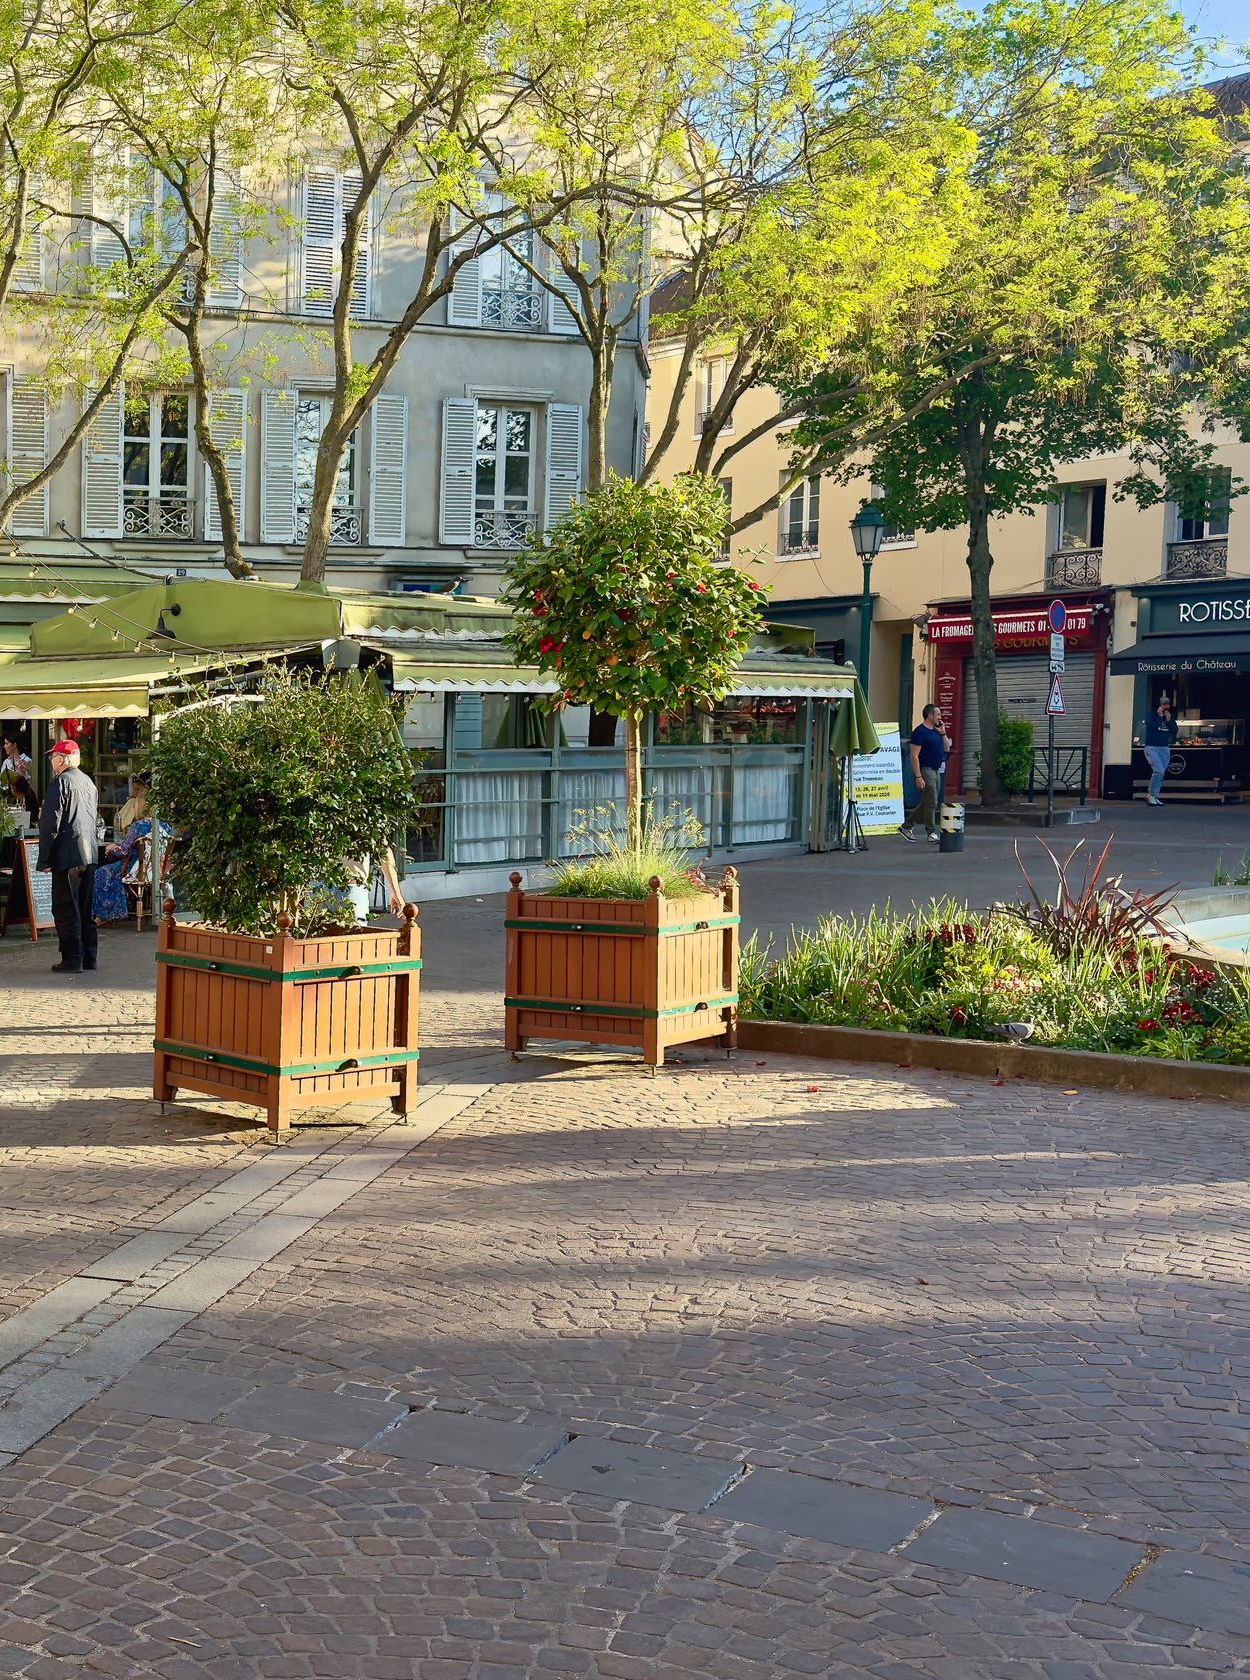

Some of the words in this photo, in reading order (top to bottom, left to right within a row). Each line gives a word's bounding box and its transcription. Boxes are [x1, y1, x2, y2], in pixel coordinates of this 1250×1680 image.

[931, 627, 940, 638] LA
[998, 620, 1035, 634] GOURMETS
[1037, 620, 1046, 632] 01
[1067, 618, 1076, 630] 01
[1077, 617, 1086, 629] 79
[1138, 662, 1177, 671] Rôtisserie
[1181, 661, 1193, 670] du
[1196, 659, 1237, 669] Château
